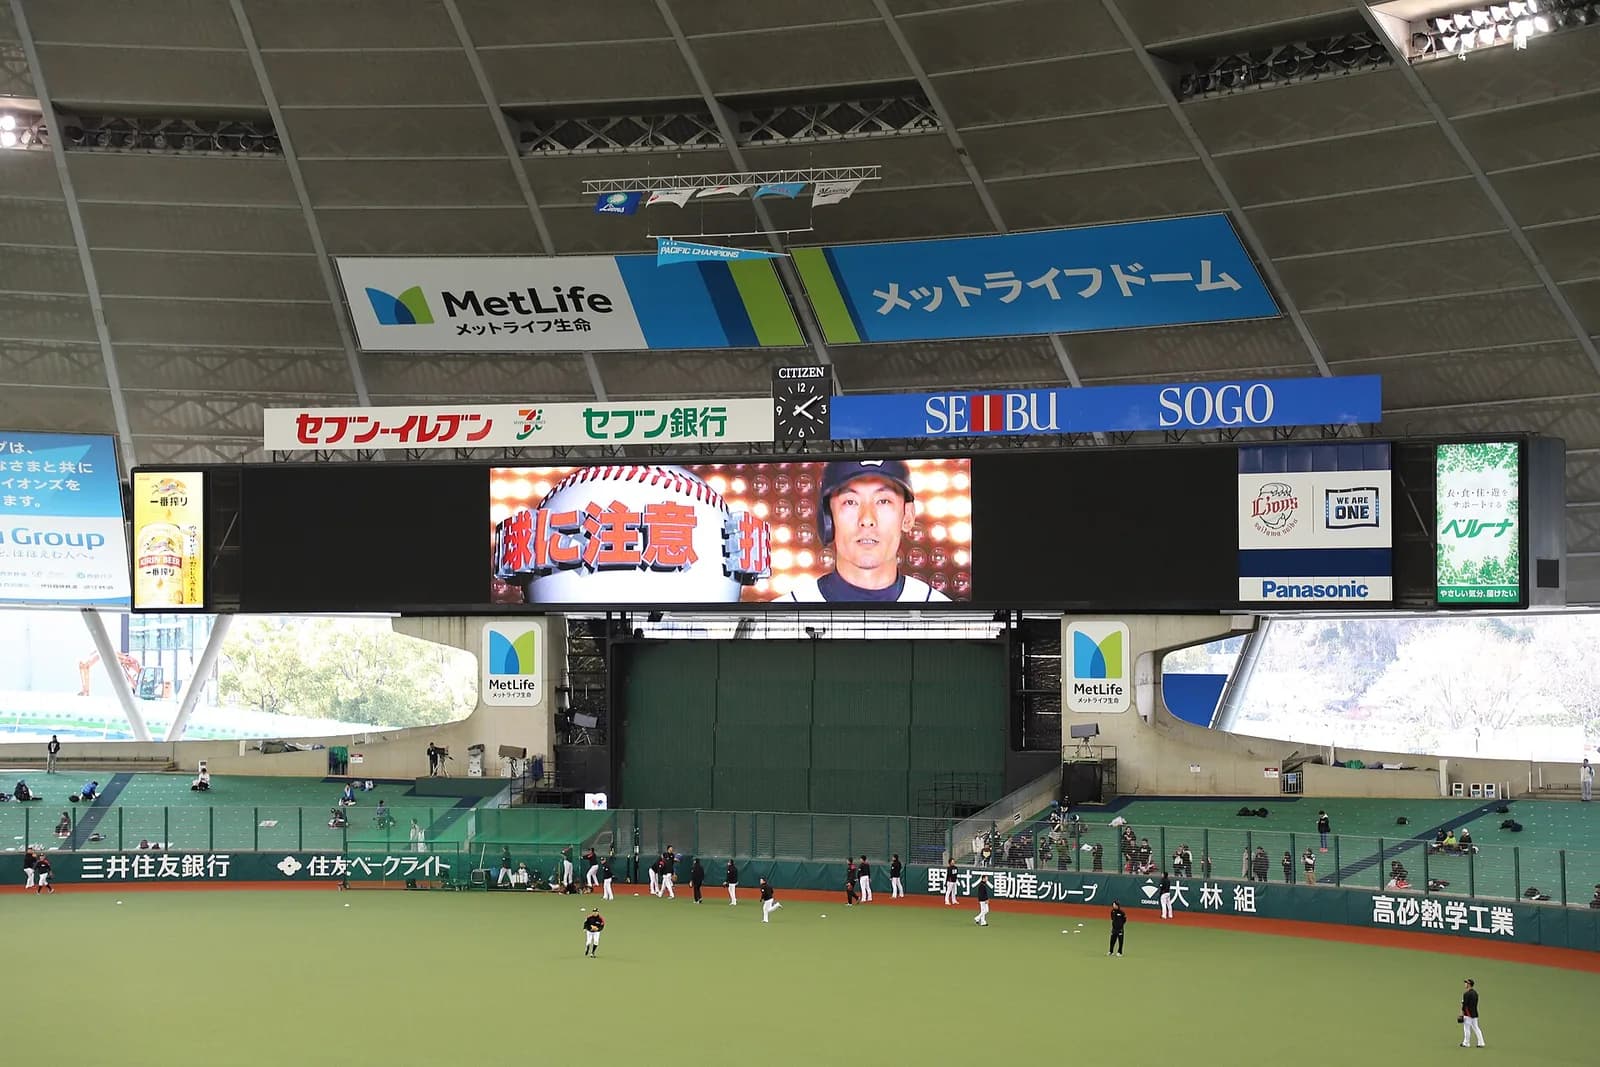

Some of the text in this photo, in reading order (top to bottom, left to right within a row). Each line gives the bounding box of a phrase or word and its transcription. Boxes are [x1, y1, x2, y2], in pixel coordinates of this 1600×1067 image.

[660, 246, 740, 258] PACIFIC CHAMPIONS
[872, 259, 1242, 317] メットライフドーム
[441, 285, 613, 318] MetLife
[455, 316, 593, 337] メットライフ生命
[778, 367, 825, 379] CITIZEN
[797, 382, 806, 393] 12
[776, 404, 827, 416] 9 3
[925, 383, 1275, 435] SEIBU SOGO
[582, 406, 728, 440] セブン銀行
[798, 427, 805, 438] 6
[1, 478, 80, 491] イオンズを
[3, 495, 40, 508] ます。
[1251, 496, 1299, 518] Lions
[1336, 496, 1369, 505] WE ARE
[1335, 504, 1370, 520] ONE
[499, 500, 699, 572] 球に注意
[1441, 518, 1514, 538] ベルーナ
[11, 527, 105, 550] Group
[1262, 580, 1369, 599] Panasonic
[489, 679, 535, 690] MetLife
[1074, 683, 1123, 695] MetLife
[80, 854, 231, 879] 三井住友銀行
[306, 855, 450, 878] 住友ベークライト
[1169, 880, 1257, 913] 大林組
[1372, 895, 1515, 937] 高砂熱学工業
